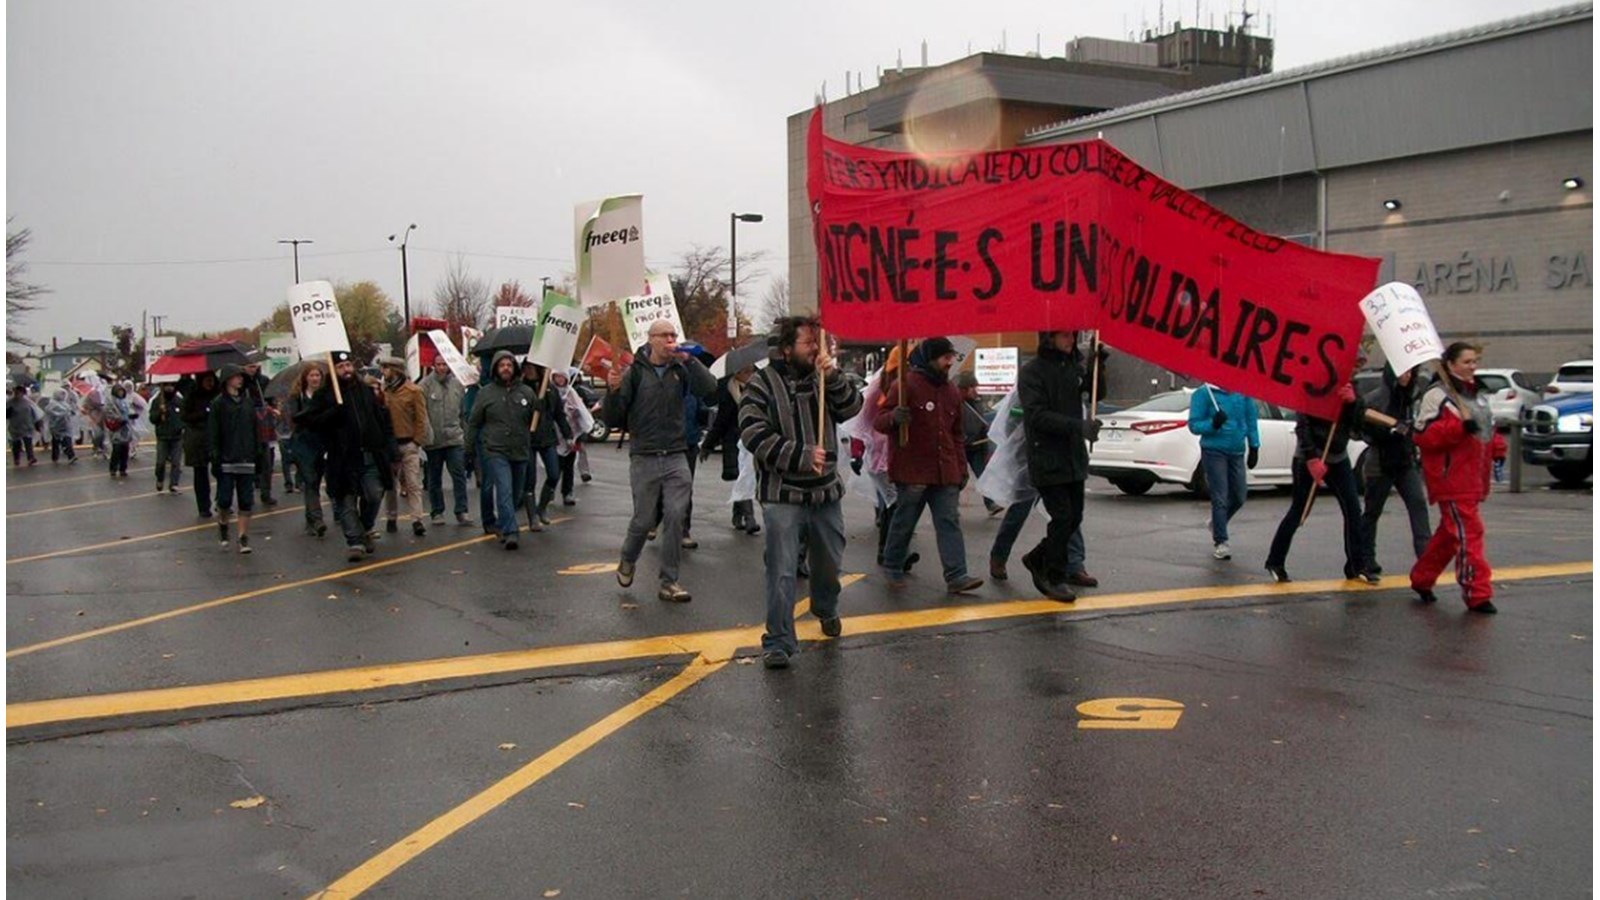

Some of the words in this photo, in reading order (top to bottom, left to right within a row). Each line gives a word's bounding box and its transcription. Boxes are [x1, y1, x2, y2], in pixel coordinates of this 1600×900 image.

[1008, 150, 1042, 181] DU
[584, 230, 628, 253] fneeq
[1414, 250, 1520, 296] ARÉNA
[625, 296, 662, 315] fneeq
[541, 312, 573, 334] fneeq
